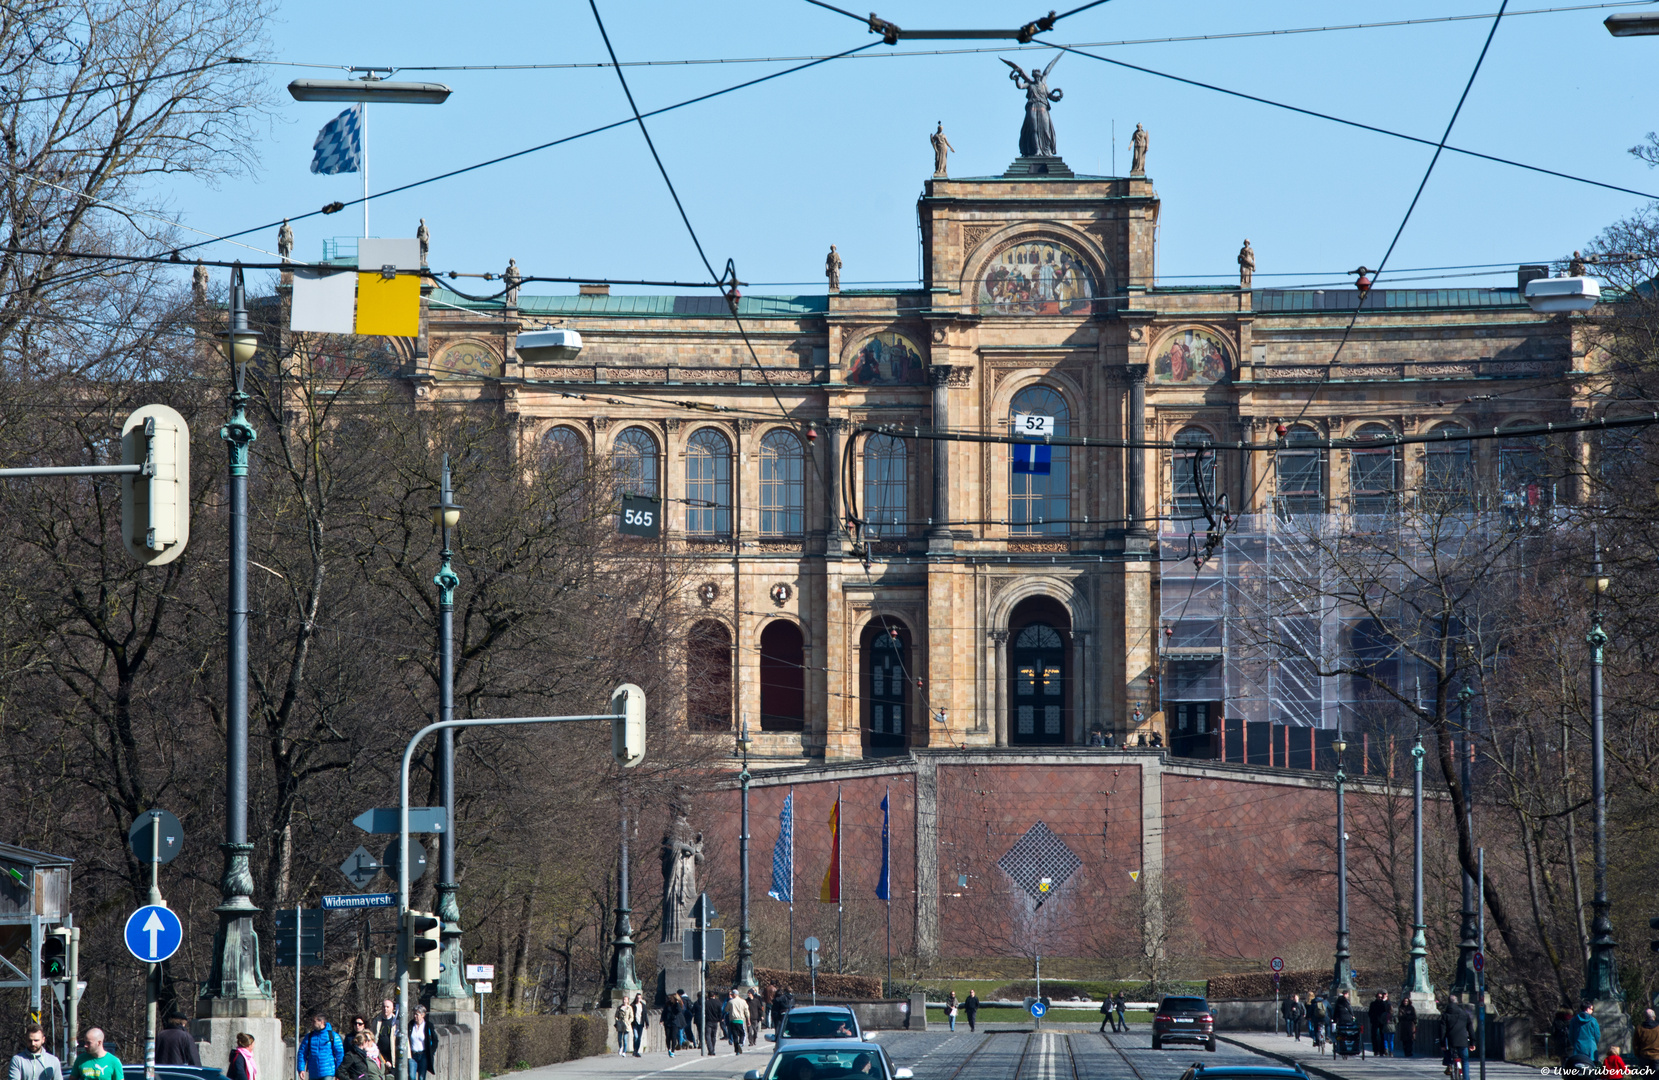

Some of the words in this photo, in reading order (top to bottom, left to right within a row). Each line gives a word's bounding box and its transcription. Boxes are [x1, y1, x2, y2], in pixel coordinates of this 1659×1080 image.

[1026, 417, 1045, 430] 52
[625, 509, 653, 527] 565
[325, 895, 394, 907] Widenmayerstr.
[1273, 960, 1281, 968] 30
